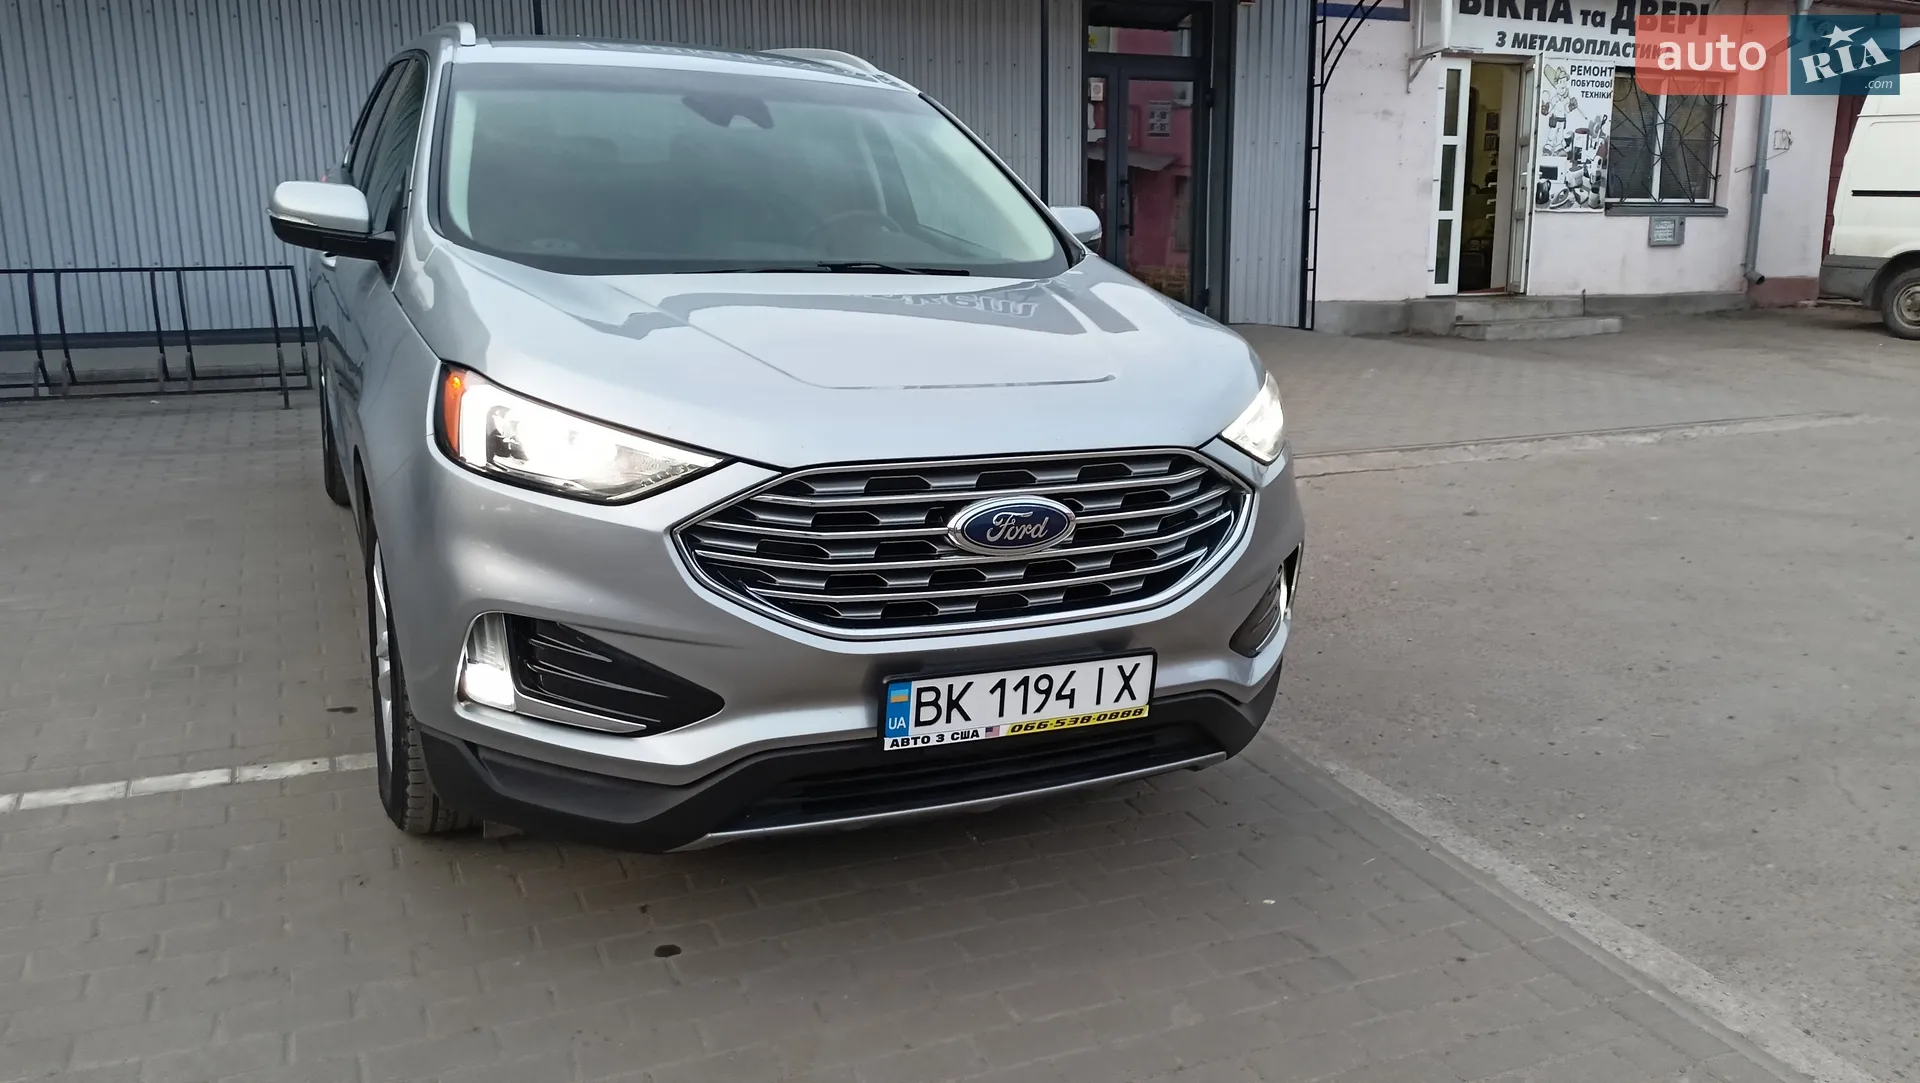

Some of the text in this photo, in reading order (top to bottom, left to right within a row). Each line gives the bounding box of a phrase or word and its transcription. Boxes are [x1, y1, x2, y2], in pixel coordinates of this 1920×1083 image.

[1580, 10, 1606, 27] та
[1610, 0, 1710, 36] ДВЕРІ
[1511, 32, 1674, 61] МЕТАЛОПЛАСТИК
[1570, 65, 1615, 77] РЕМОНТ
[1581, 90, 1612, 99] ТЕХНІКИ
[986, 511, 1049, 542] Ford
[914, 662, 1141, 728] BK 1194 IX
[888, 717, 907, 730] UA
[890, 735, 931, 749] АВТО
[951, 729, 980, 741] США
